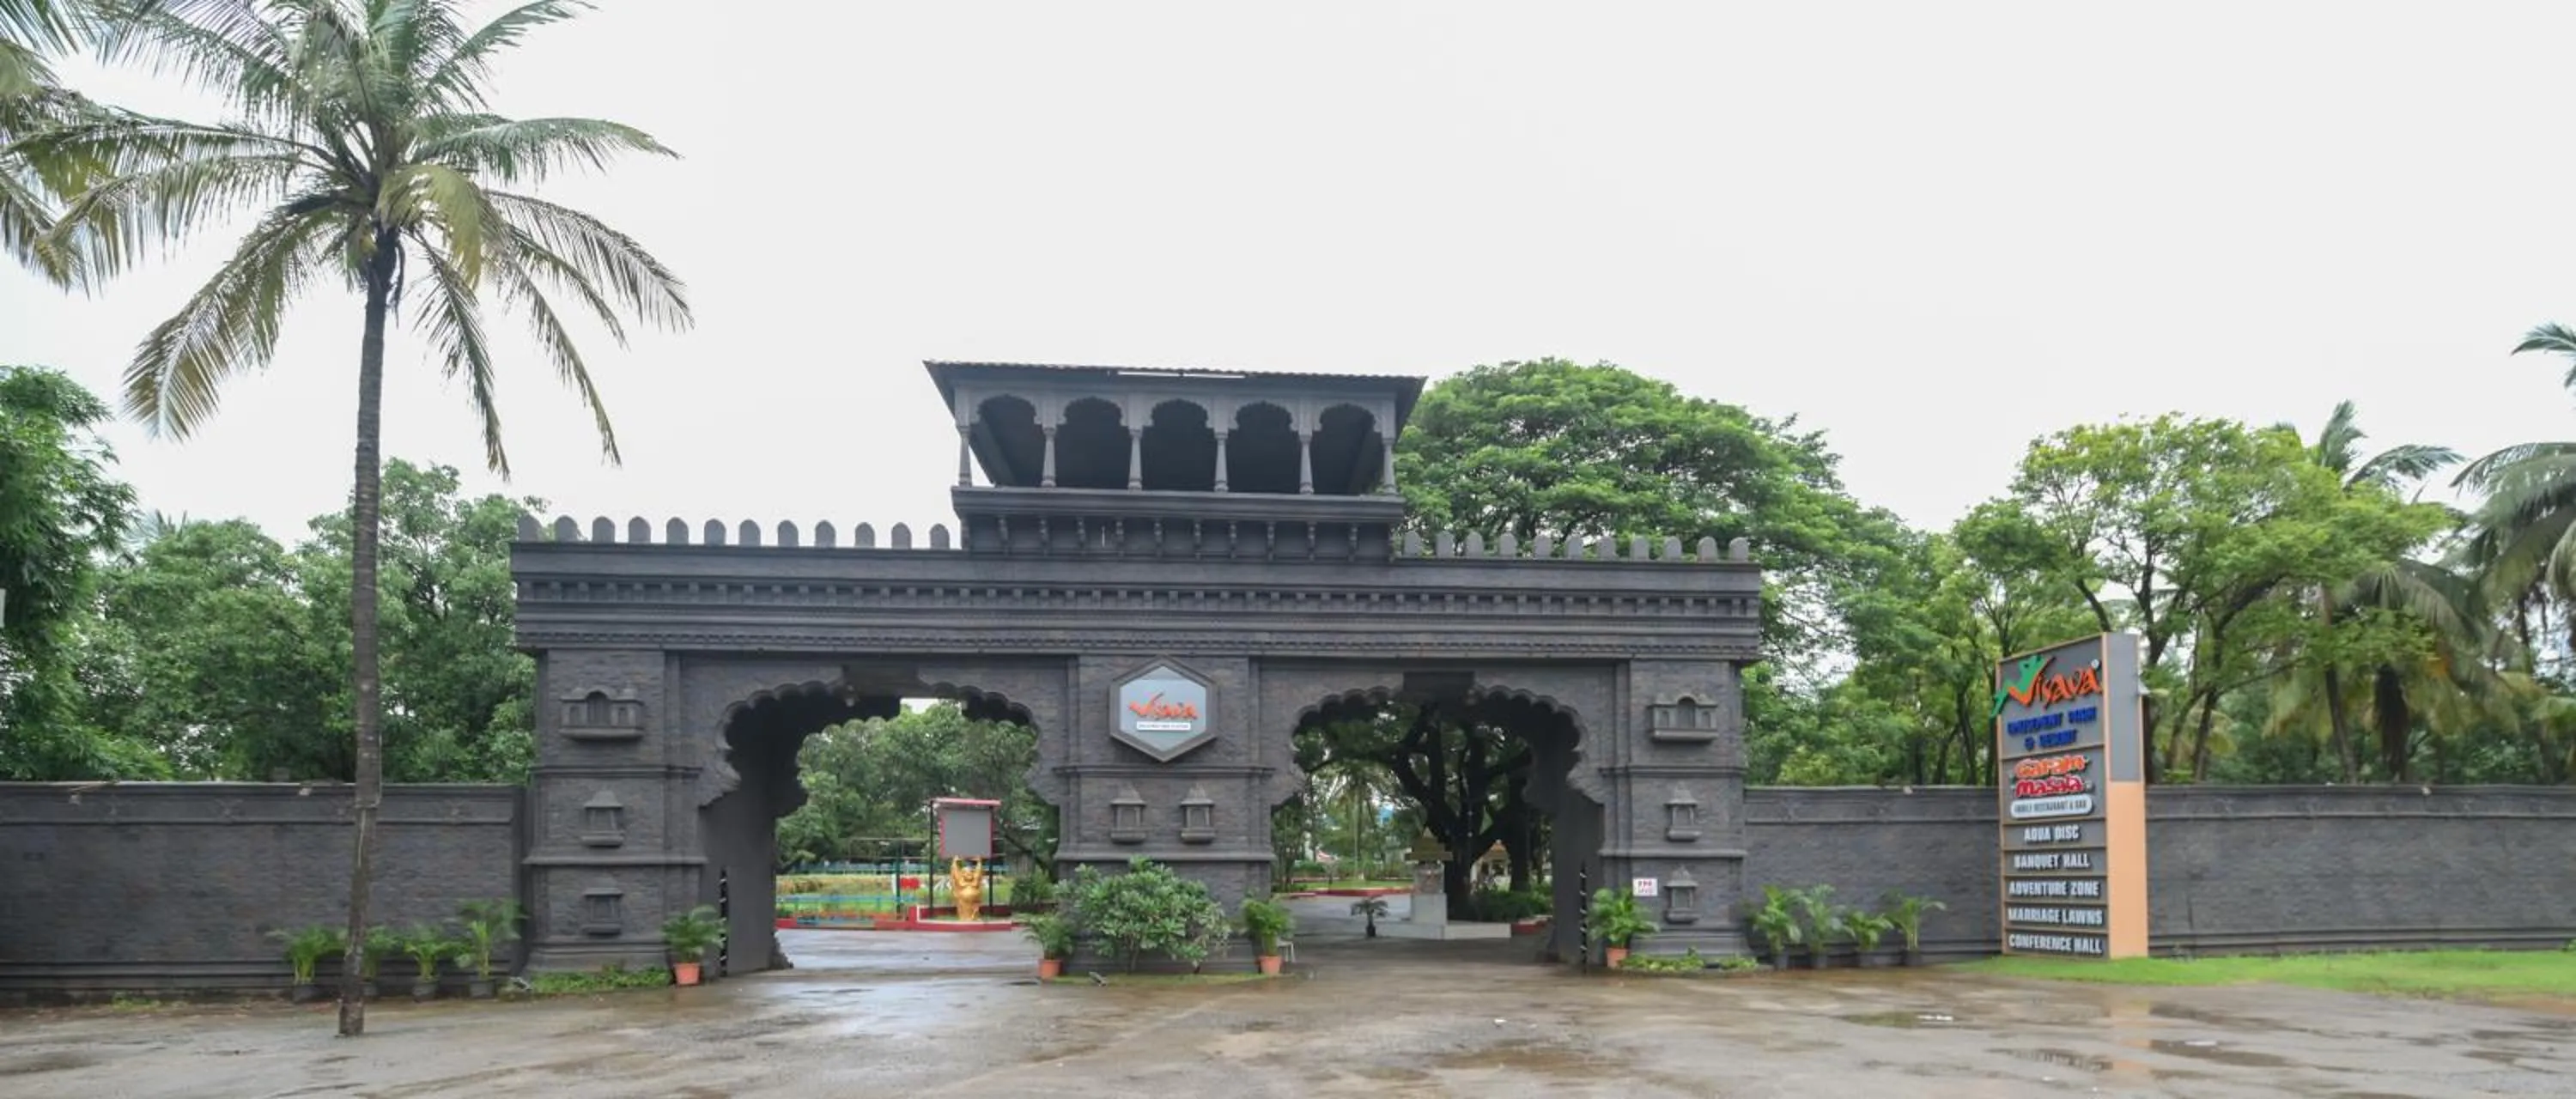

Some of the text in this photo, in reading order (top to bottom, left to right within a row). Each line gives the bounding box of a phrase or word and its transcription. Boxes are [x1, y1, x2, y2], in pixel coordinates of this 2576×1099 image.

[2024, 824, 2080, 841] AQUA DISC
[2014, 853, 2090, 870] BANQUET HALL
[2008, 880, 2099, 896] ADVENTURE ZONE
[2008, 907, 2102, 925] MARRIAGE LAWNS
[2008, 933, 2102, 954] CONFERENCE HALL
